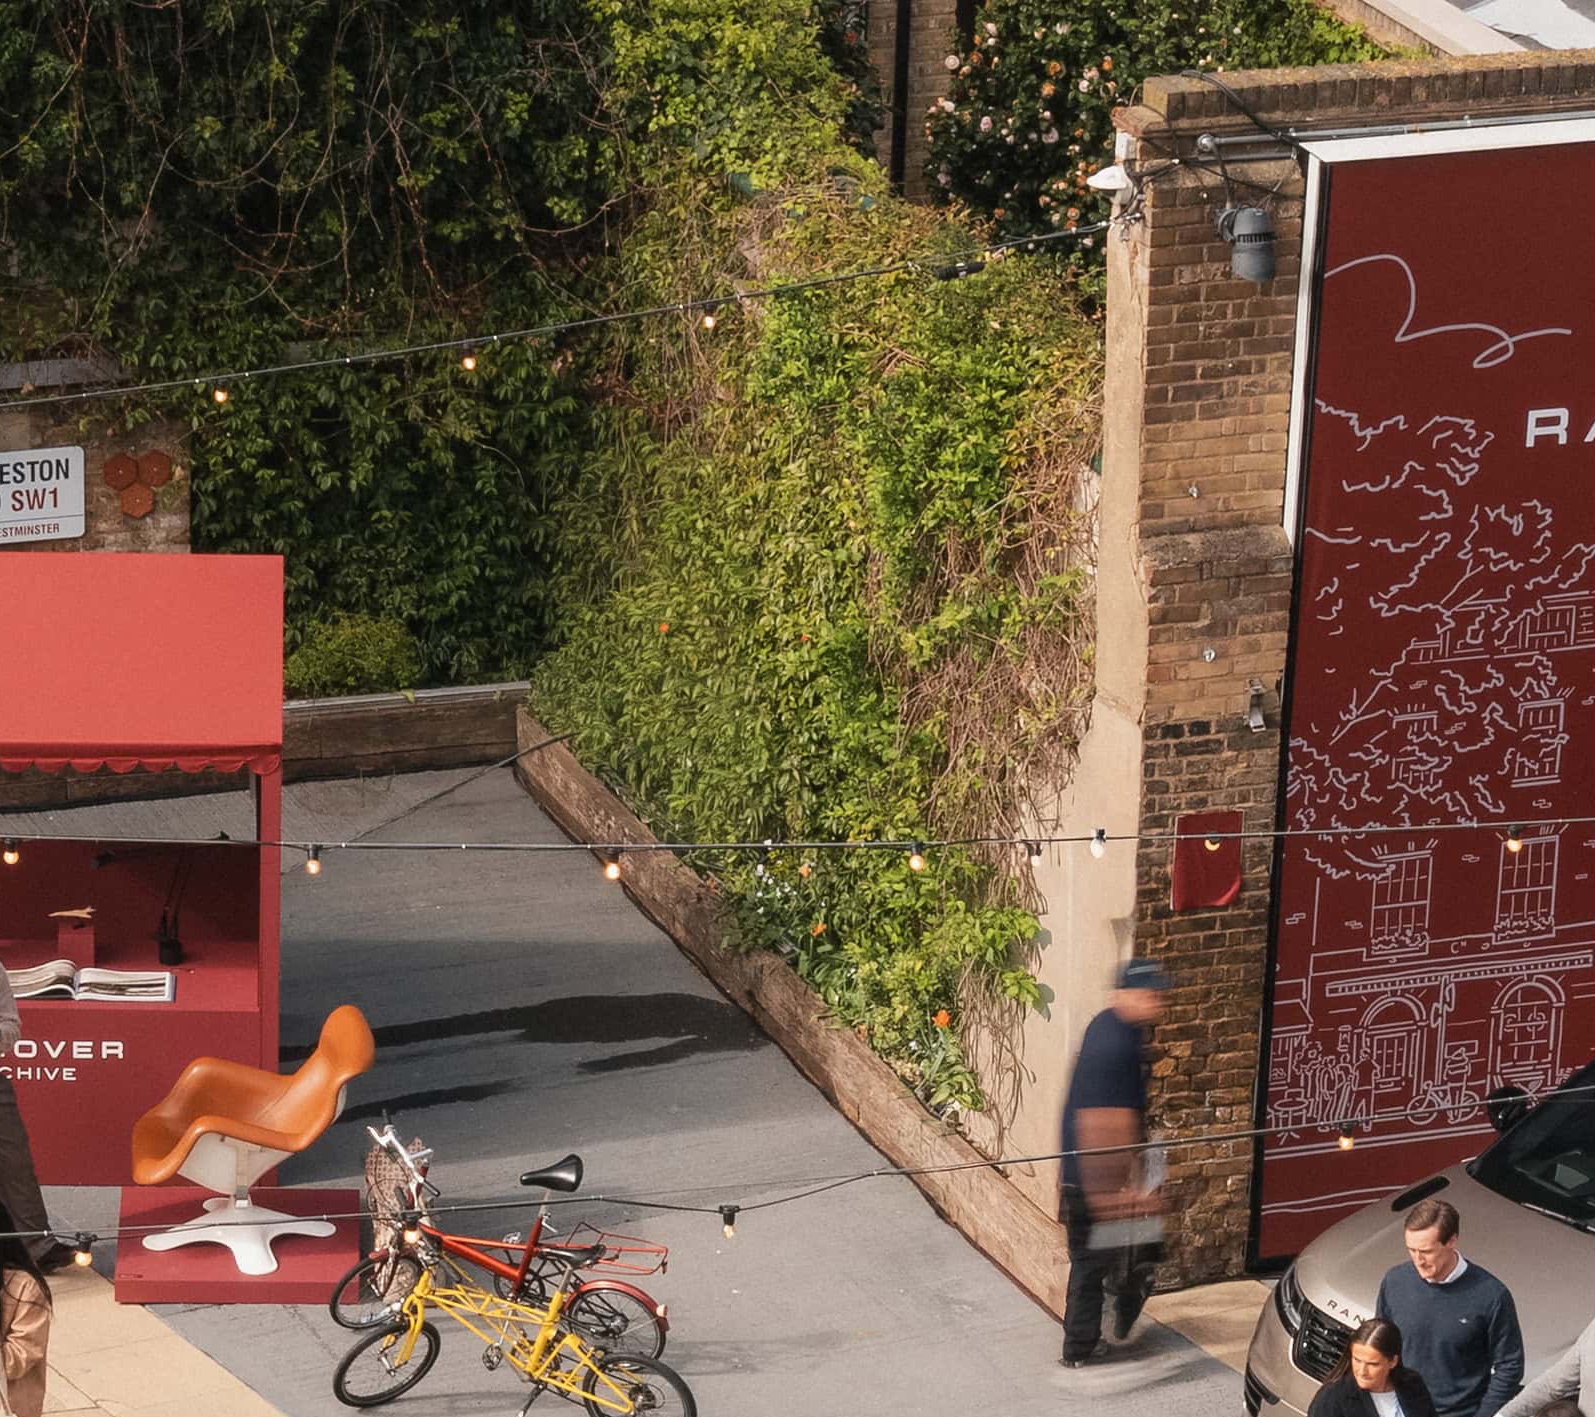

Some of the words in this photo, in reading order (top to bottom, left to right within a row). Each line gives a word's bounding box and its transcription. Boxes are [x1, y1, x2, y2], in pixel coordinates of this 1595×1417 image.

[11, 487, 59, 512] SW1
[0, 1040, 124, 1059] OVER
[1327, 1299, 1366, 1323] RAN
